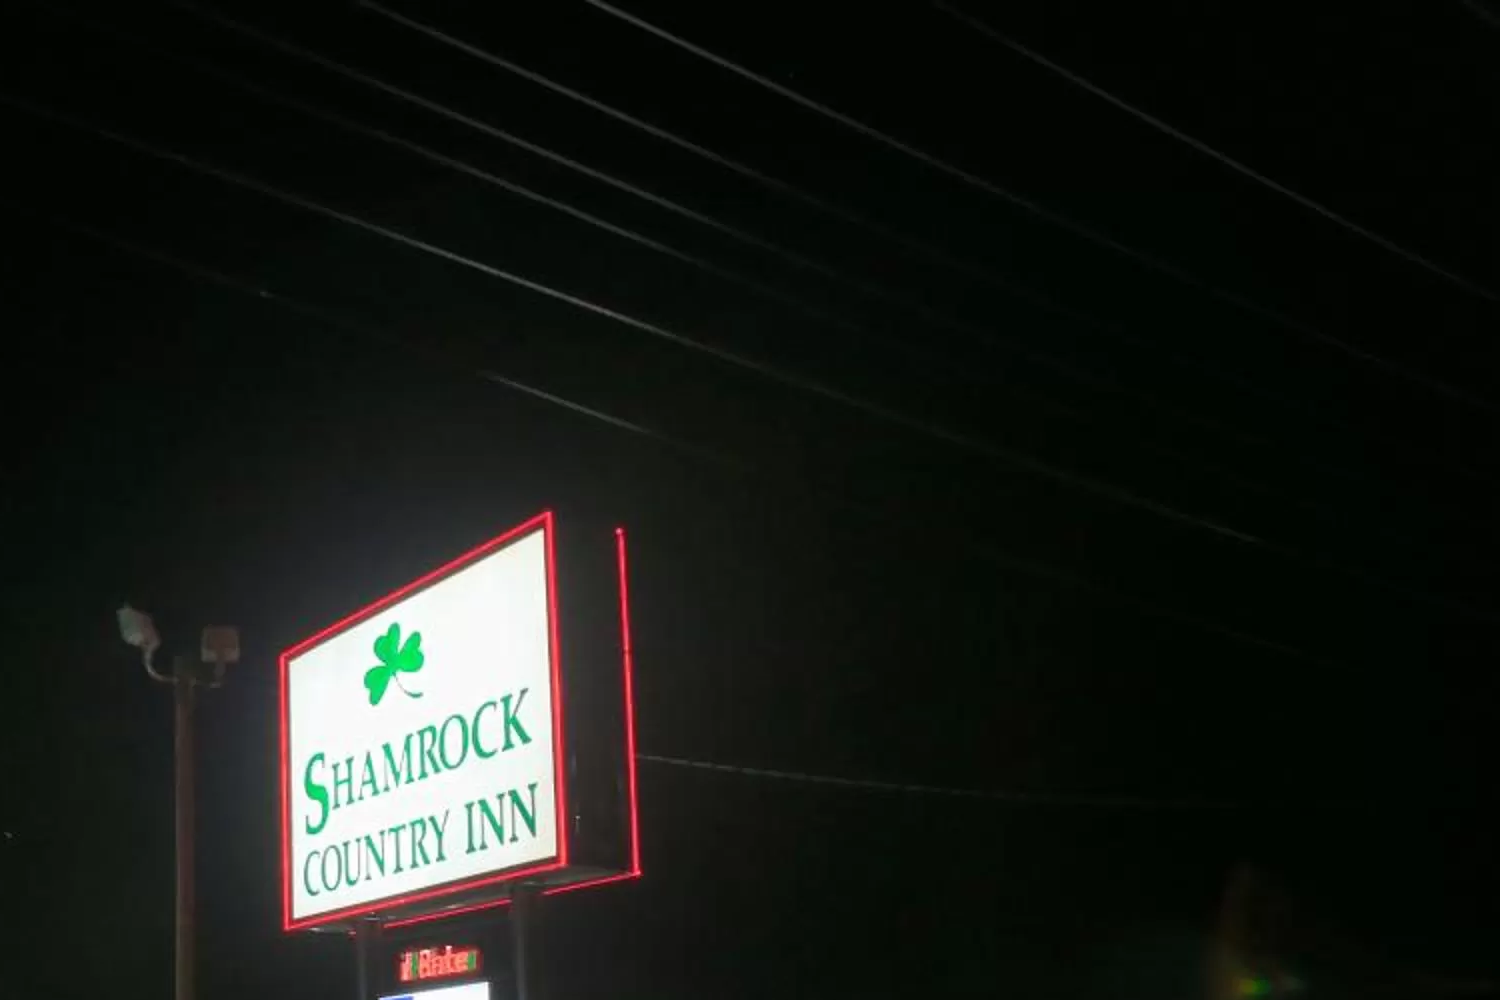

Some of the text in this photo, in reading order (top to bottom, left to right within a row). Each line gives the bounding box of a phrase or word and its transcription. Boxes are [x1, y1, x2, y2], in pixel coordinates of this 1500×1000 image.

[303, 688, 532, 835] SHAMROCK
[302, 783, 539, 897] COUNTRY INN
